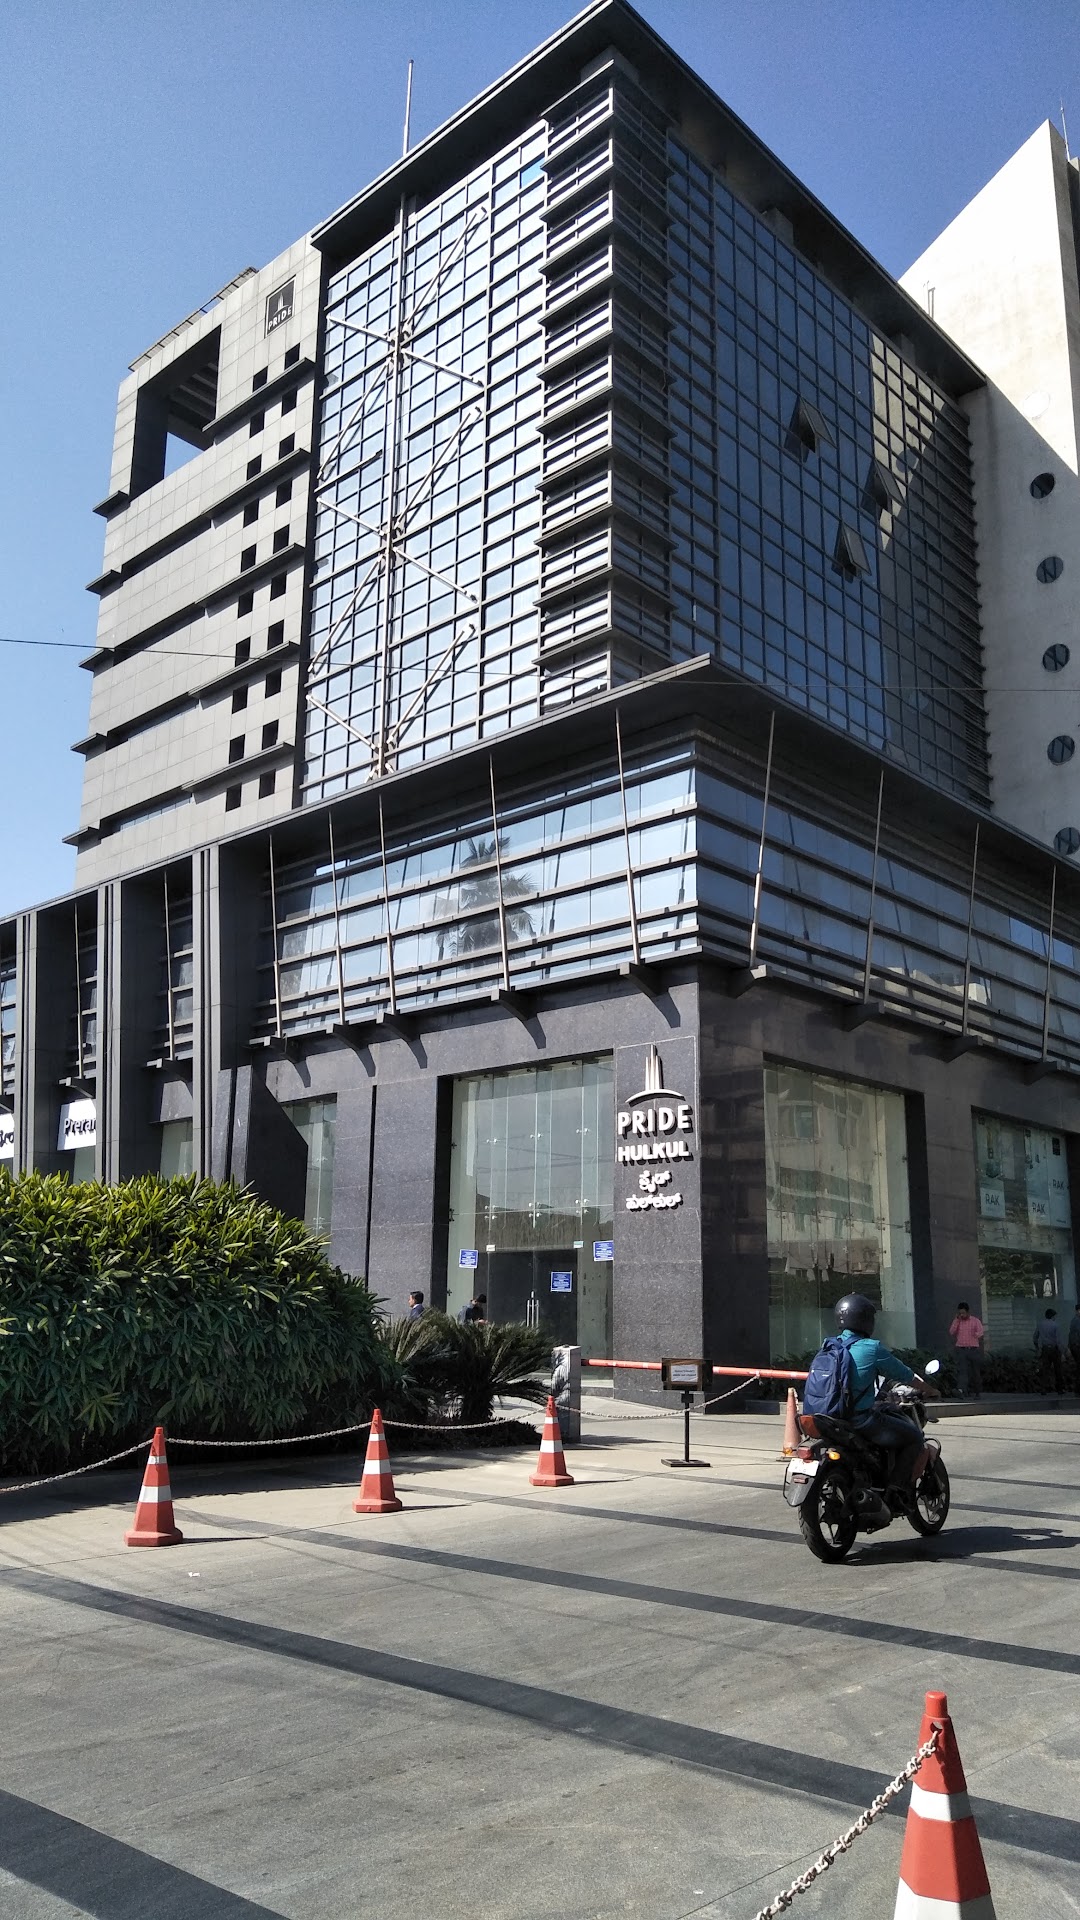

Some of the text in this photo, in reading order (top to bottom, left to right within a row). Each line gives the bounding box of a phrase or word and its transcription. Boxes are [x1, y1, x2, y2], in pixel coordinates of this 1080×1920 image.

[268, 305, 292, 330] PRIDE
[617, 1105, 691, 1135] PRIDE
[617, 1140, 690, 1162] HULKUL
[1052, 1179, 1065, 1191] RAK
[985, 1193, 1000, 1206] RAK
[1031, 1201, 1046, 1214] RAK
